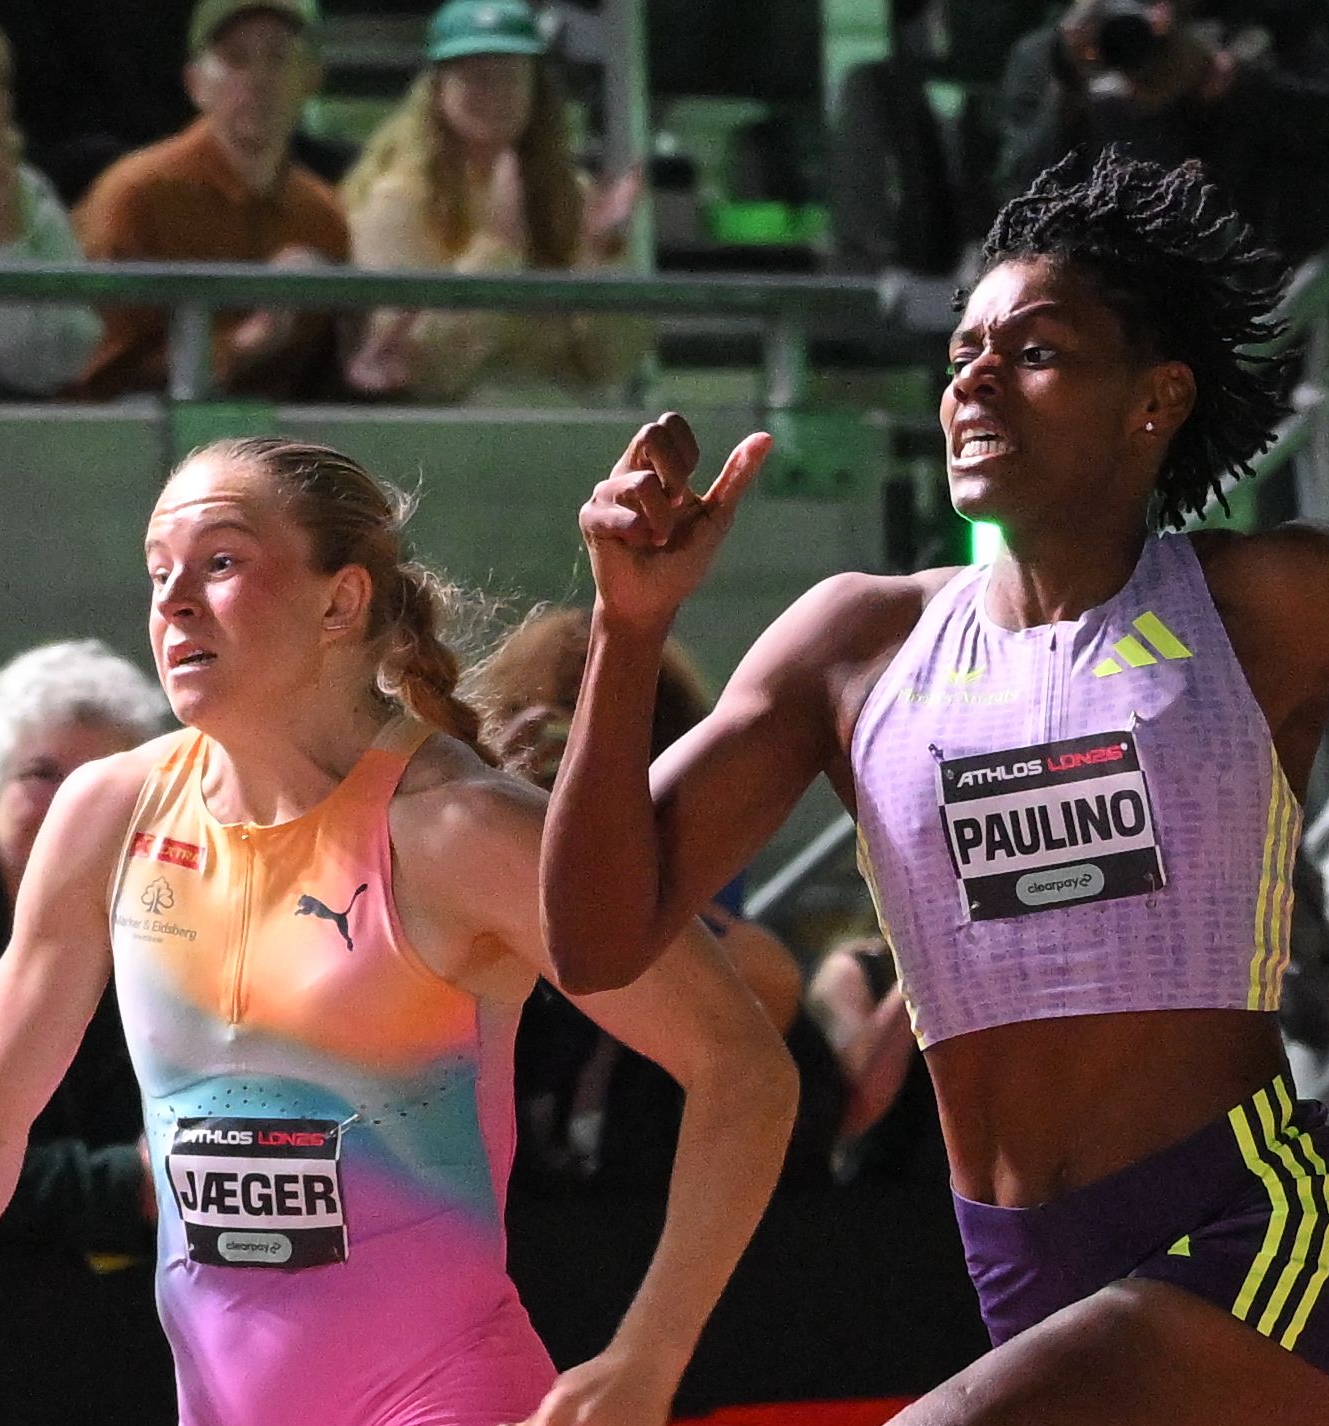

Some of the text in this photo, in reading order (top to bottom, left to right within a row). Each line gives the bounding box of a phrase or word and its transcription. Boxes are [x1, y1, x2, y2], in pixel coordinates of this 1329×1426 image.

[957, 759, 1043, 788] ATHLOS
[952, 788, 1147, 866] PAULINO
[1027, 875, 1080, 894] clearpay
[181, 1129, 253, 1145] ATHLOS
[180, 1170, 338, 1216] JÆGER
